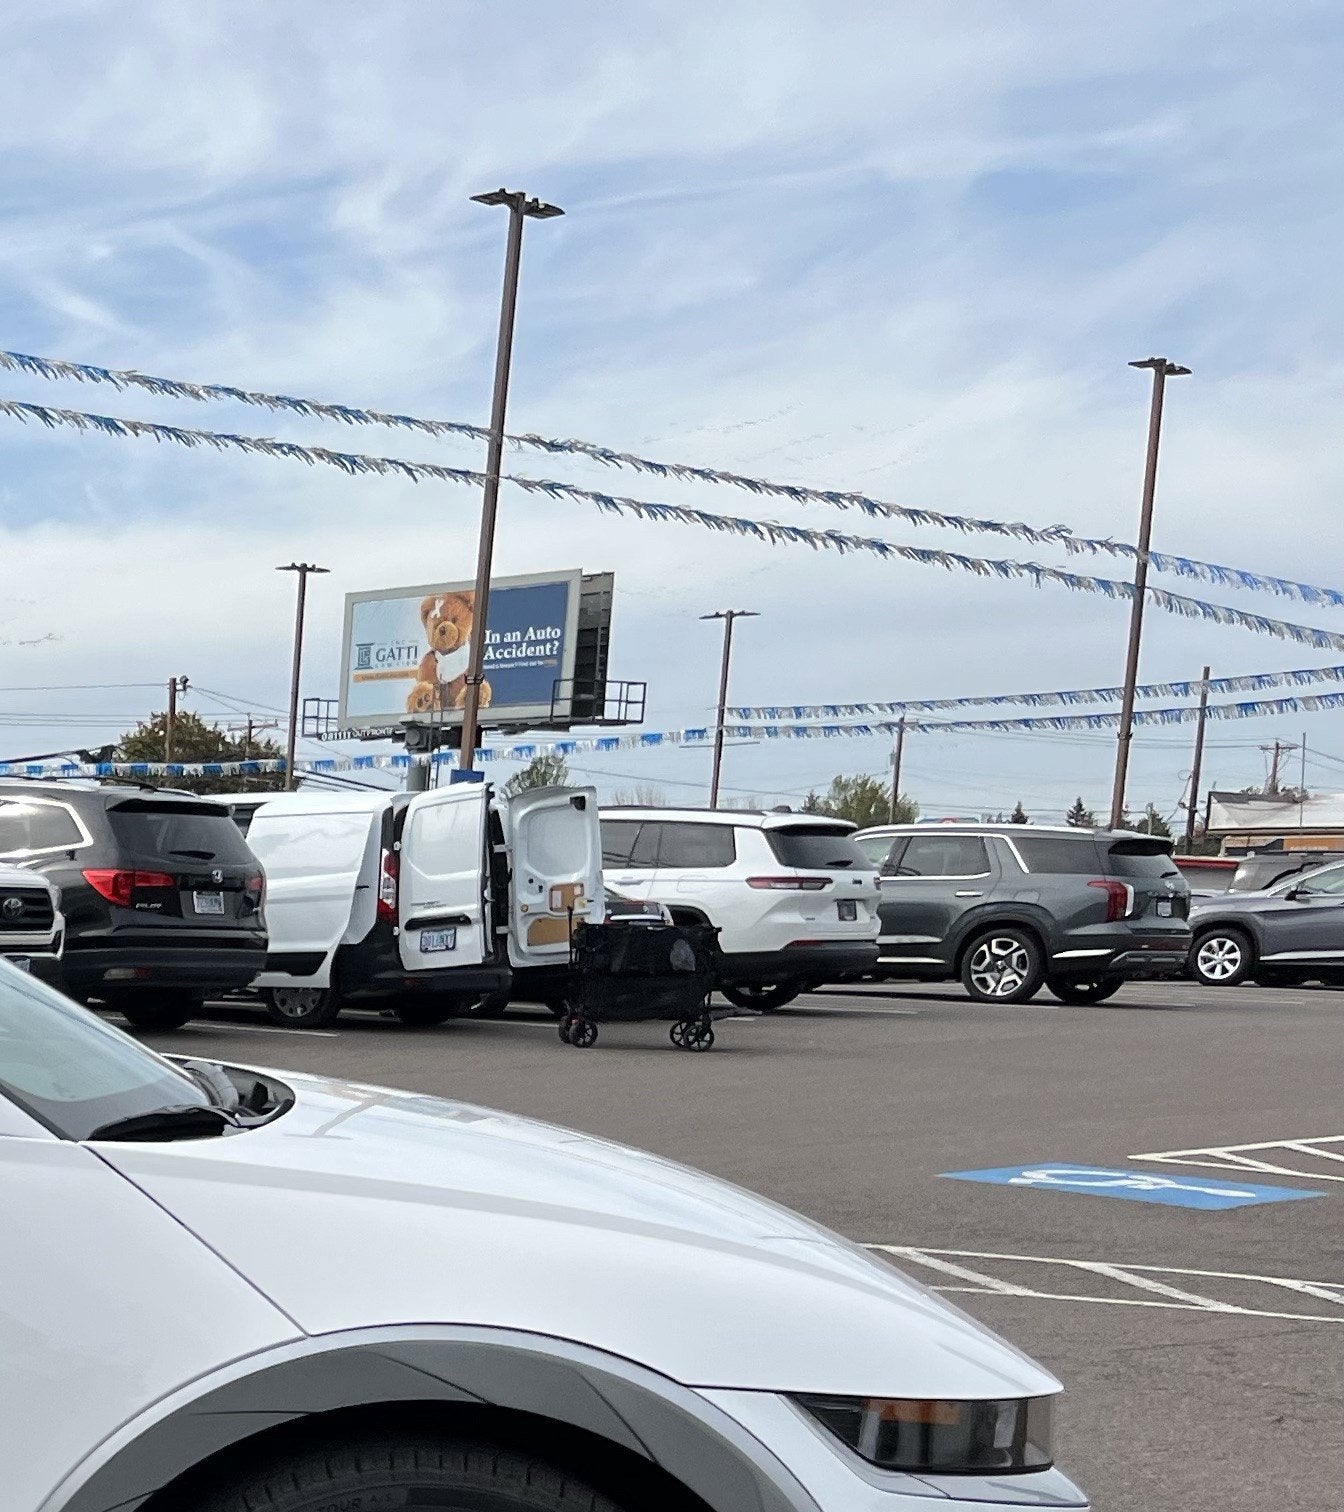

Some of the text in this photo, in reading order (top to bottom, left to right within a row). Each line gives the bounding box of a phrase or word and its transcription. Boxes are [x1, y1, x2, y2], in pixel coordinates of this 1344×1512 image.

[484, 626, 561, 644] In an Auto
[375, 645, 418, 662] GATTI
[483, 640, 560, 660] Accident?
